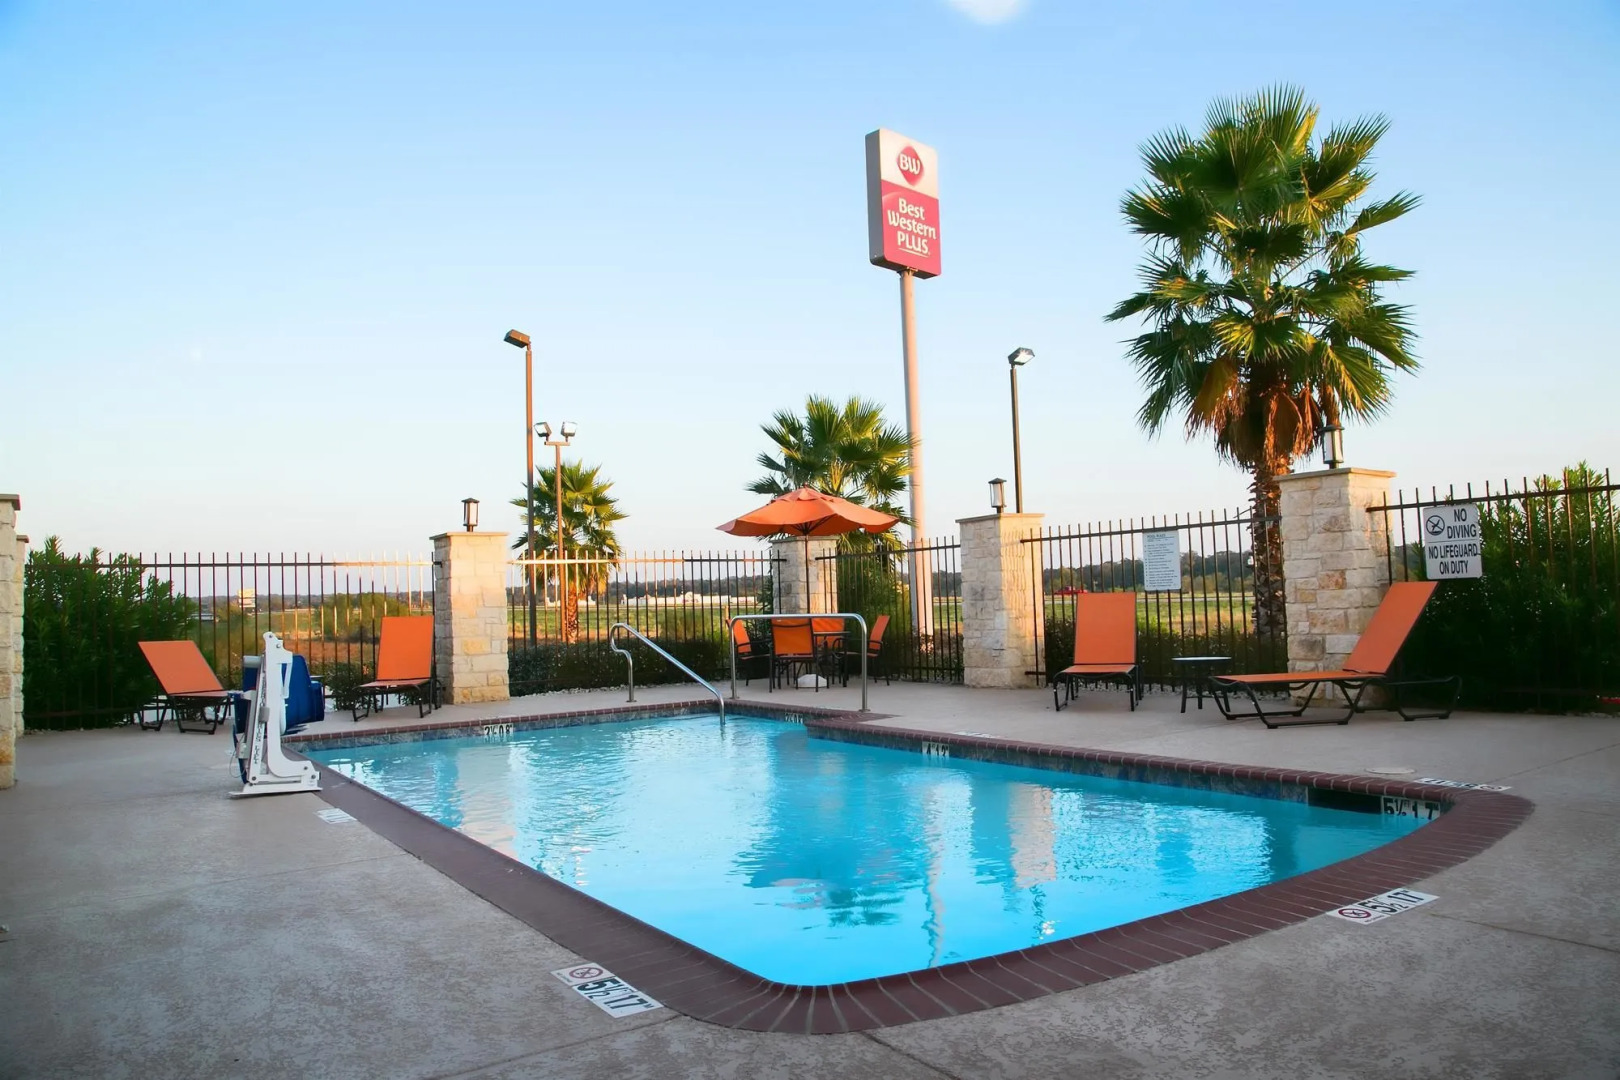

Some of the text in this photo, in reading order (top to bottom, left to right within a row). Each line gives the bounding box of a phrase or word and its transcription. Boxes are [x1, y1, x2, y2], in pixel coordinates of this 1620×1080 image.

[900, 153, 921, 175] BW
[898, 197, 926, 220] Best
[887, 209, 937, 240] Western
[897, 231, 929, 254] PLUS
[1453, 508, 1467, 522] NO
[1447, 523, 1477, 539] DIVING
[1428, 543, 1478, 559] NO LIFEGUARD
[1439, 560, 1469, 575] ON DUTY
